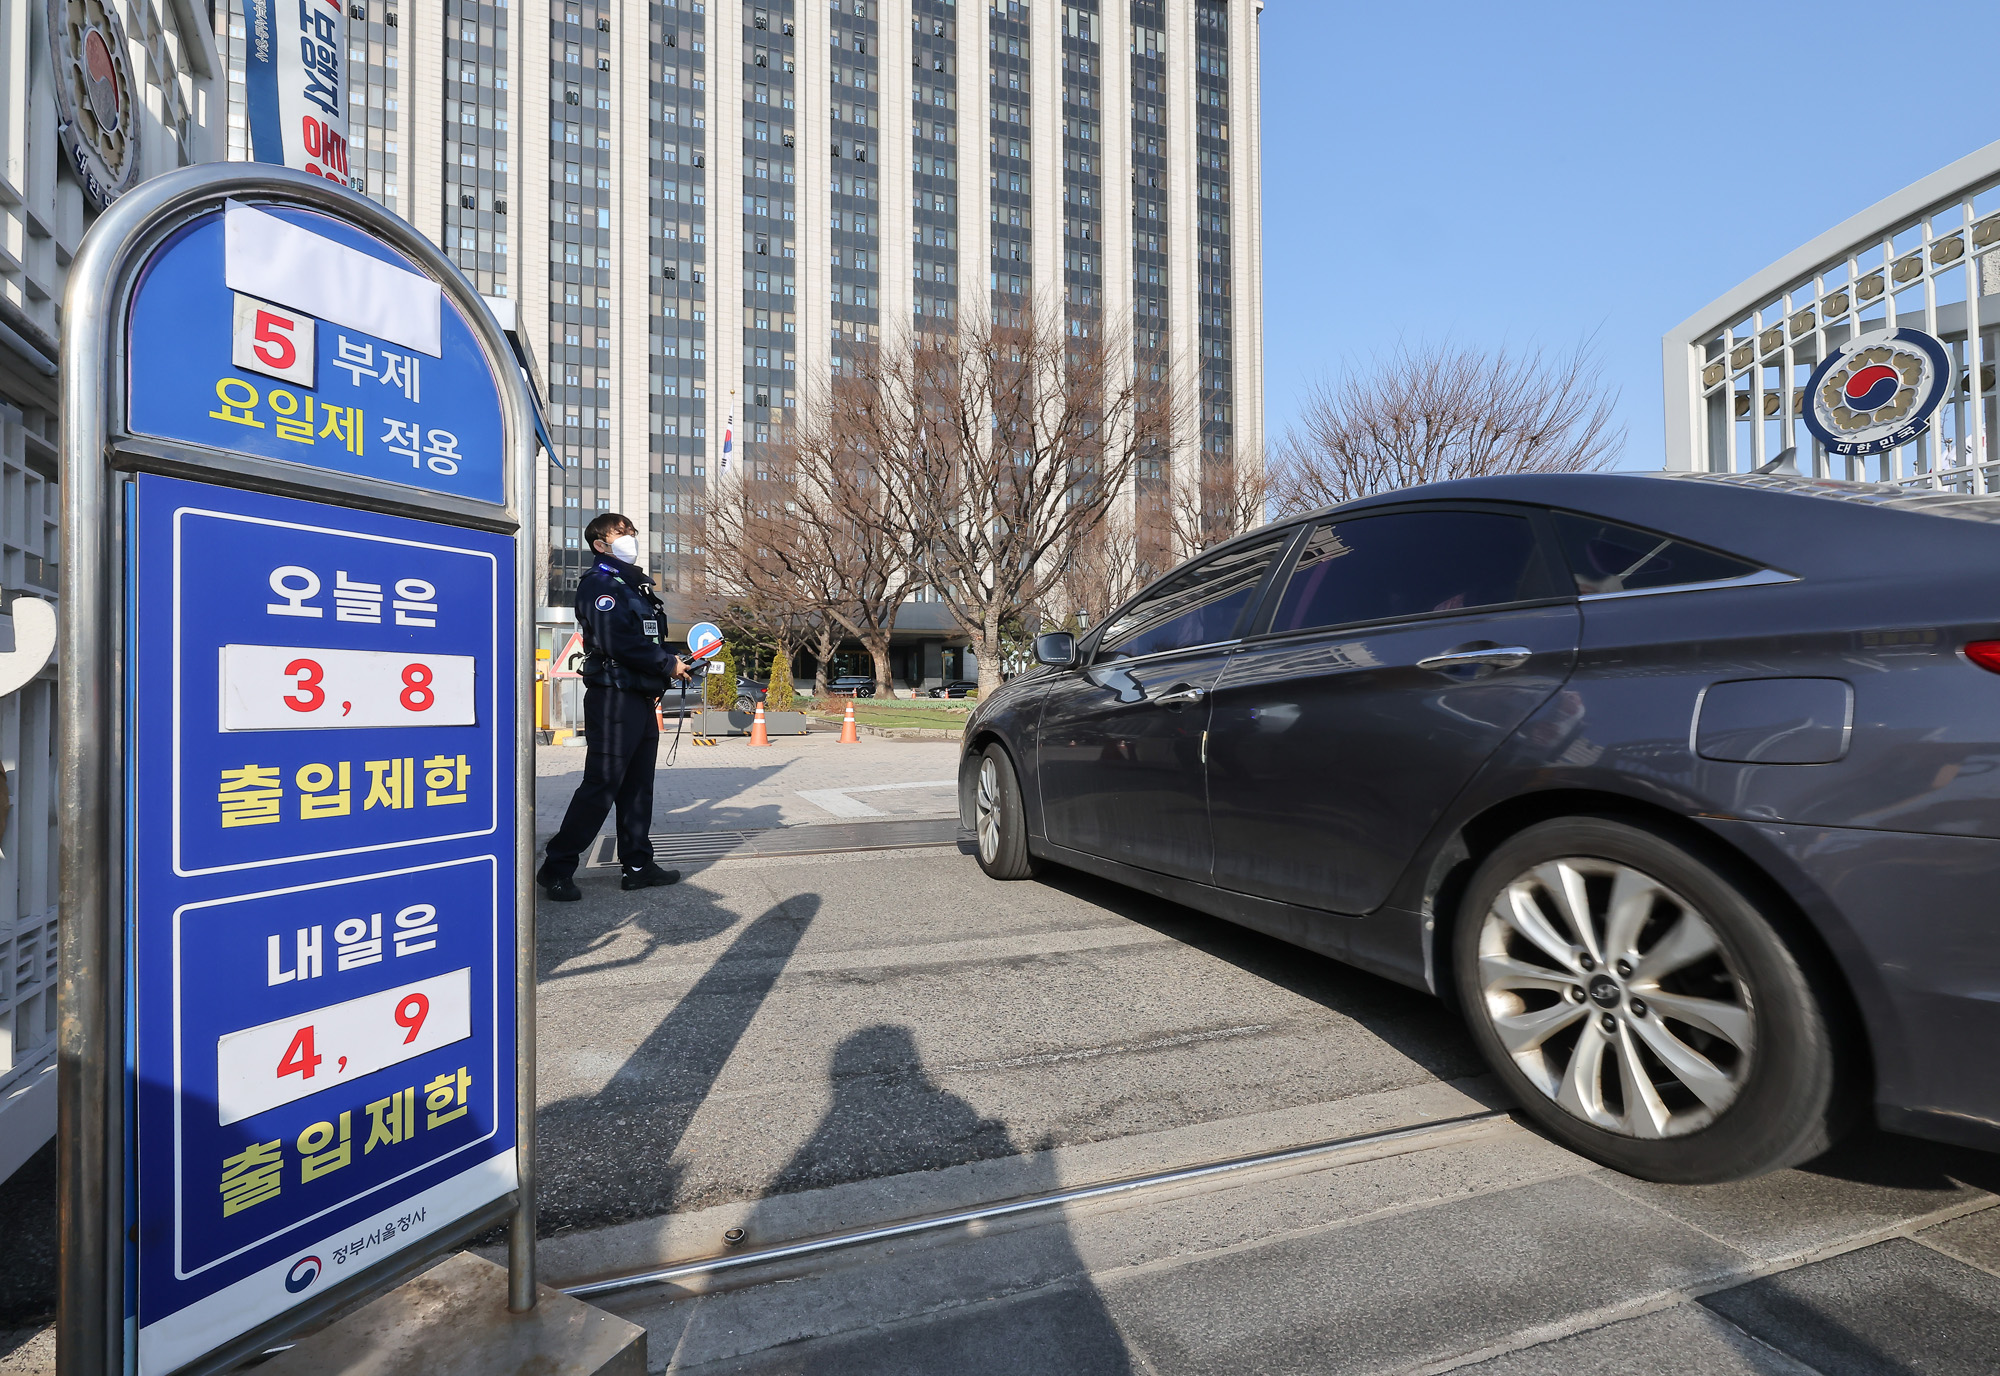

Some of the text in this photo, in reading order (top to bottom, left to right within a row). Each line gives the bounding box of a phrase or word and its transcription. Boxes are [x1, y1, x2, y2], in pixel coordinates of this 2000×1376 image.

[299, 0, 349, 187] 보행자 통
[253, 309, 420, 404] 5 부제
[209, 377, 463, 476] 요일제 적용
[1836, 425, 1916, 454] 대한민국
[266, 565, 438, 628] 오늘은
[283, 658, 435, 717] 3, 8
[218, 754, 471, 829] 출입제한
[267, 903, 439, 987] 내일은
[276, 992, 430, 1080] 4, 9
[219, 1066, 473, 1219] 출입제한
[332, 1206, 427, 1265] 정부서울청사
